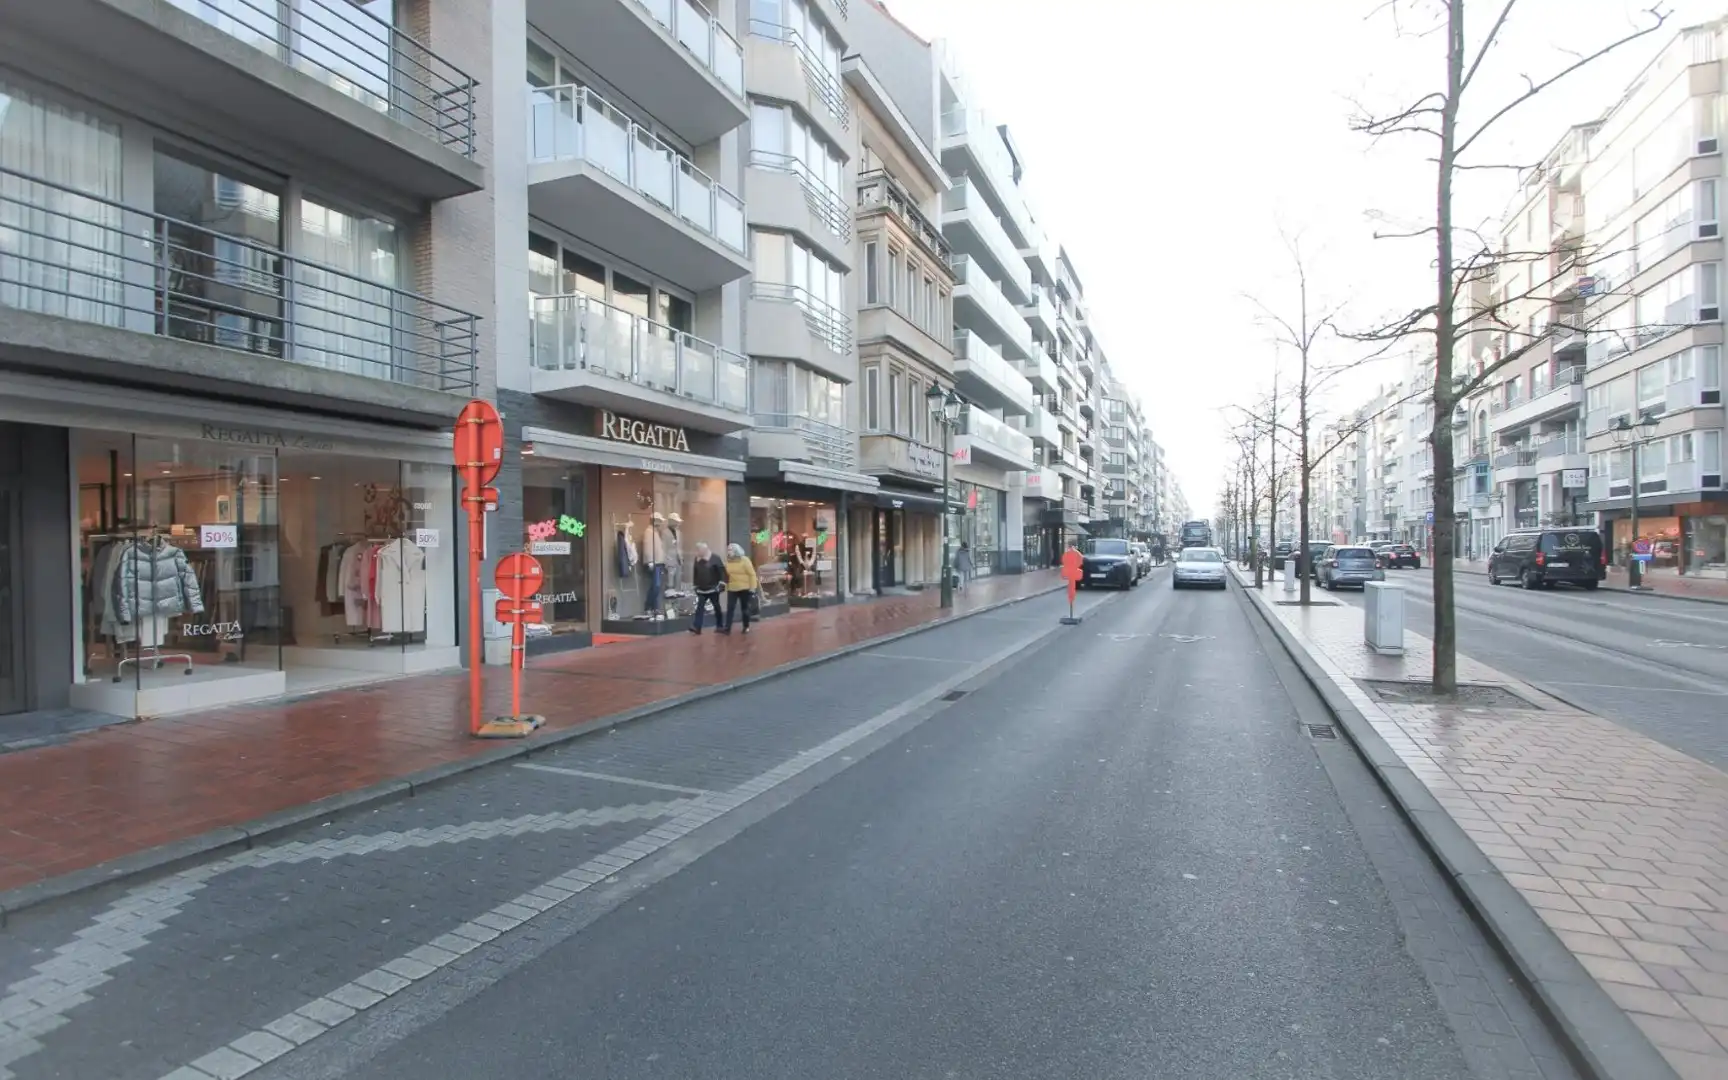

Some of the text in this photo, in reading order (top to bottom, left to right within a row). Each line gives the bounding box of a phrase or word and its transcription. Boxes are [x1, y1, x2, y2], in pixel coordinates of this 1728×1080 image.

[201, 422, 287, 447] REGATTA
[600, 410, 690, 452] REGATTA
[641, 459, 674, 473] REGATTA
[205, 532, 234, 543] 50%
[419, 533, 437, 543] 50%
[535, 590, 578, 604] REGATTA
[183, 620, 242, 637] REGATTA
